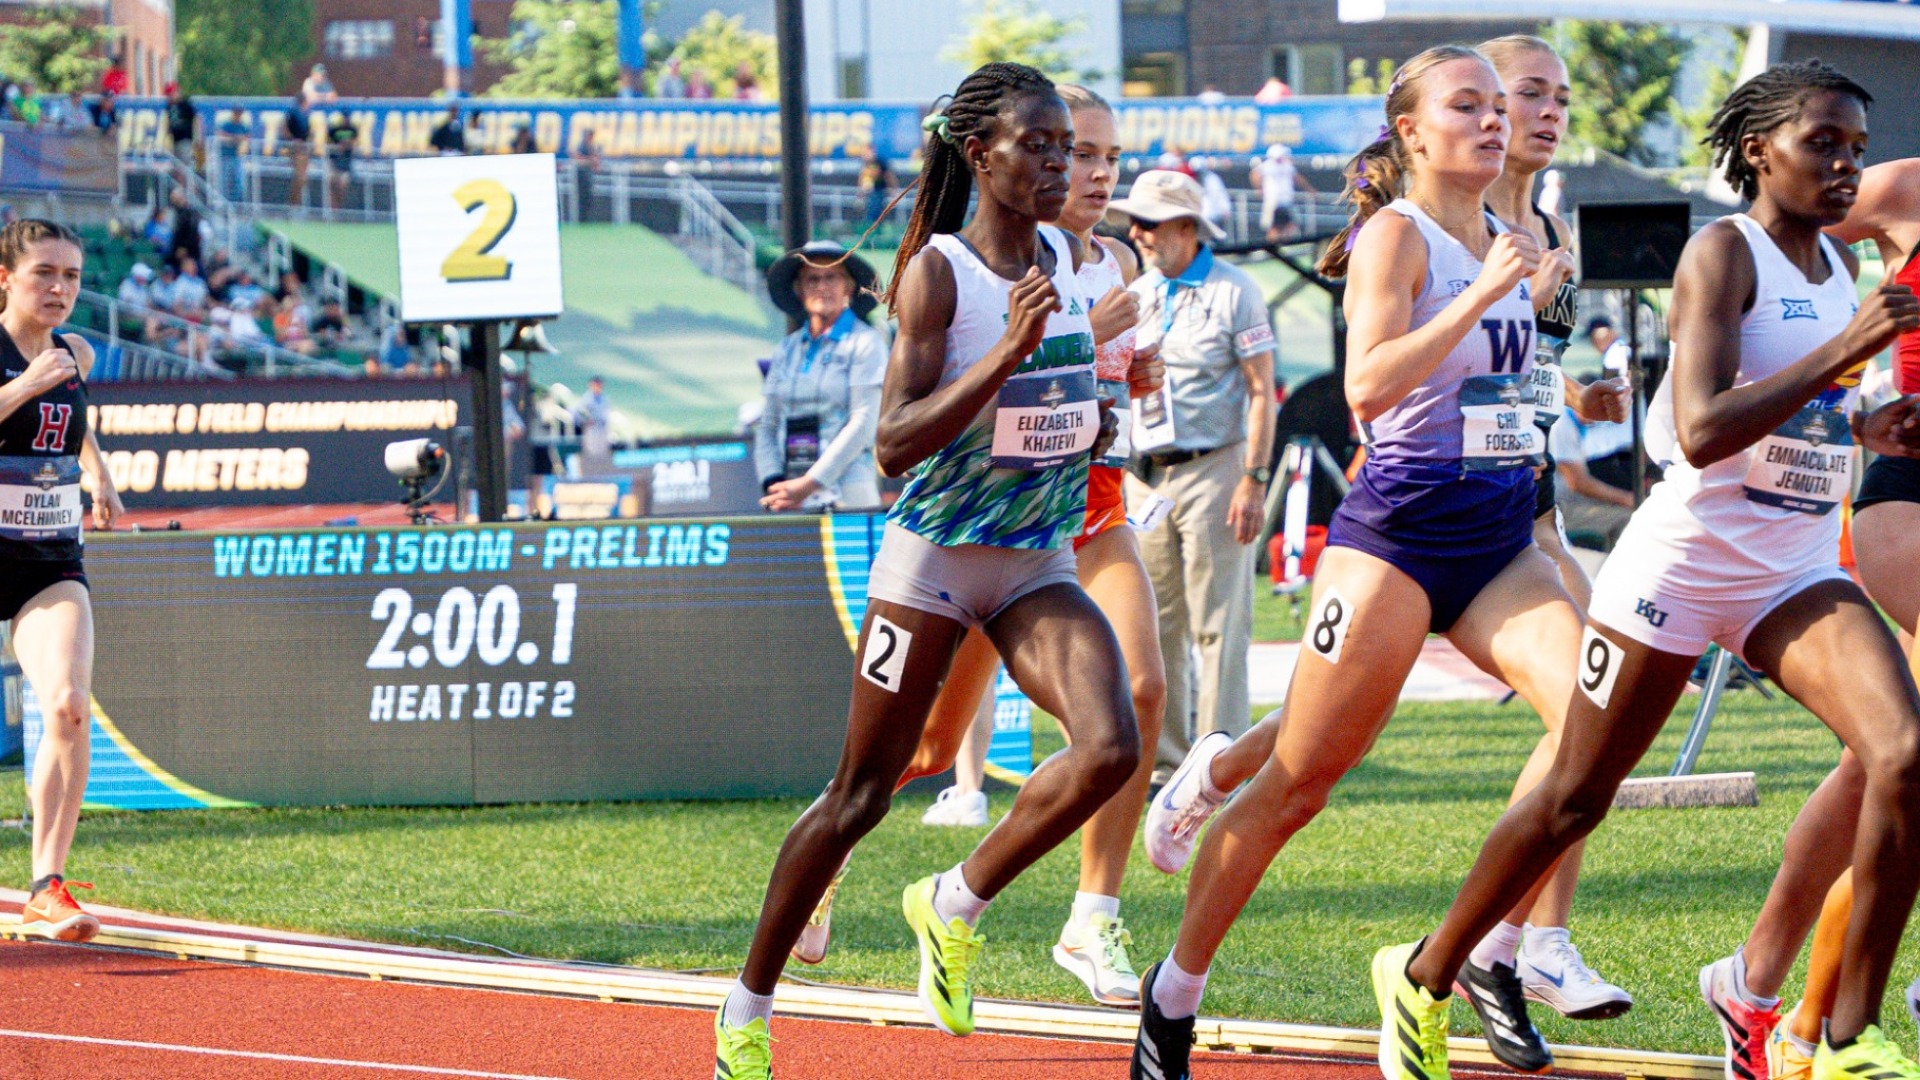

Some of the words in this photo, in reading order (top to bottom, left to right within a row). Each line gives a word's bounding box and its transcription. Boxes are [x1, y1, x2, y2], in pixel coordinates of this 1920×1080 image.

[568, 110, 875, 158] CHAMPIONSIPS
[440, 177, 517, 283] 2
[1480, 319, 1533, 373] W
[32, 402, 73, 452] H
[100, 403, 176, 435] TRACK
[198, 402, 265, 434] FIELD
[1017, 410, 1084, 432] ELIZABETH
[1022, 432, 1077, 452] KHATEVI
[1765, 444, 1847, 474] EMMACULATE
[162, 446, 310, 492] METERS
[1774, 470, 1833, 496] JEMUTAI
[1, 509, 73, 526] MCELHINNEY
[24, 492, 61, 508] DYLAN
[213, 533, 367, 578] WOMEN
[370, 528, 514, 575] 1500M
[541, 522, 732, 571] PRELIMS
[365, 582, 578, 669] 2:00.1
[1313, 597, 1343, 655] 8
[1634, 597, 1669, 628] KU
[867, 624, 897, 685] 2
[1582, 637, 1610, 692] 9
[369, 683, 471, 722] HEAT
[498, 680, 549, 719] OF
[551, 680, 577, 718] 2
